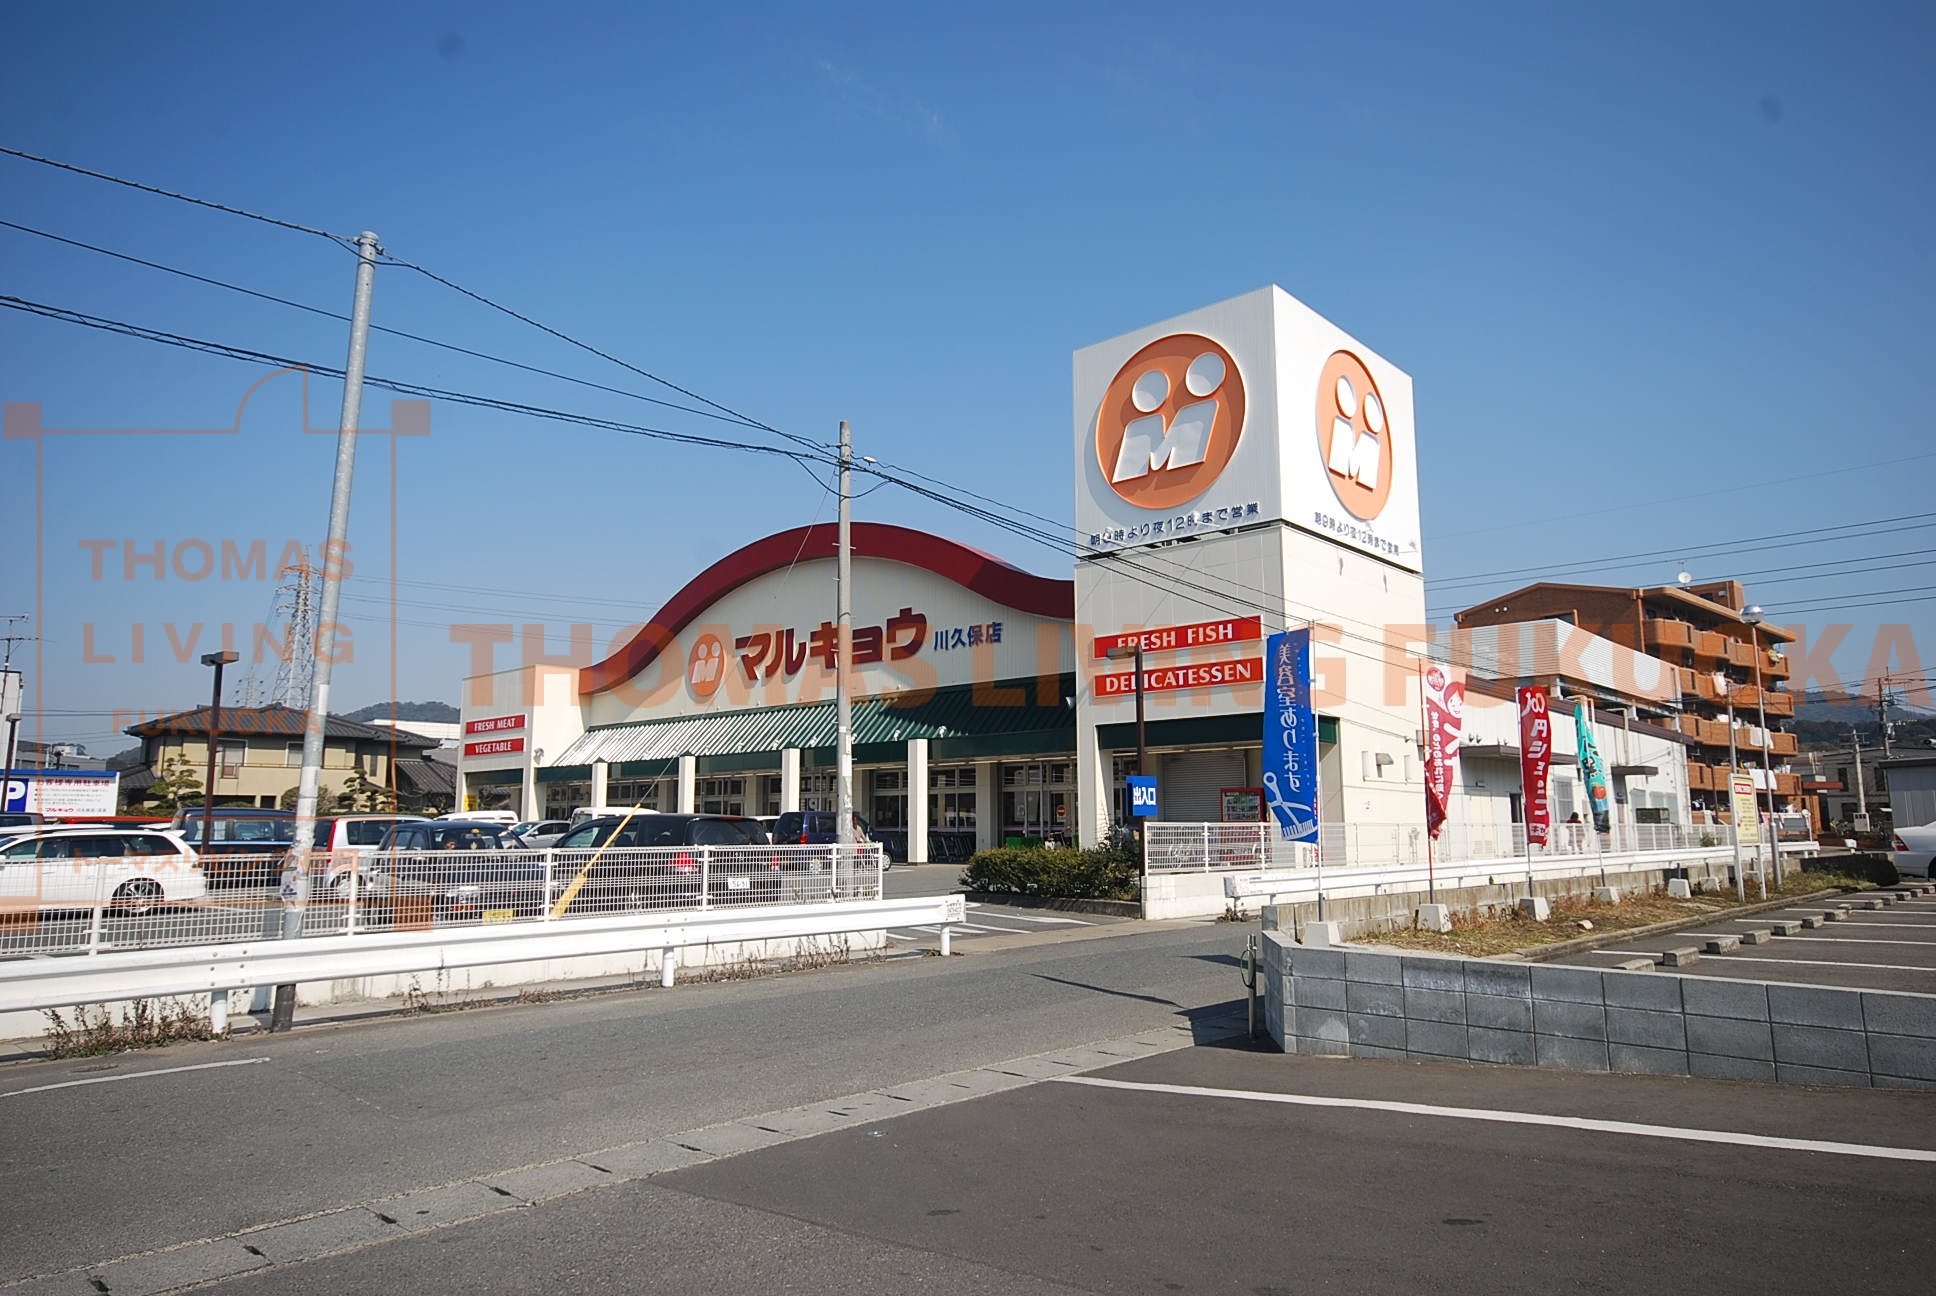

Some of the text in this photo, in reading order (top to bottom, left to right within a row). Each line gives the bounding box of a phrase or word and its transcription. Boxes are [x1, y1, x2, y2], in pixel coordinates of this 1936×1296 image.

[735, 607, 927, 681] マルキョウ
[933, 621, 1003, 651] 川久保店
[1117, 623, 1233, 650] FRESH FISH
[1105, 662, 1252, 692] DELICATESSEN
[474, 718, 516, 732] FRESH MEAT
[1276, 643, 1301, 792] 美容室あります
[475, 741, 512, 753] VEGETABLE
[1132, 786, 1157, 806] 出入口
